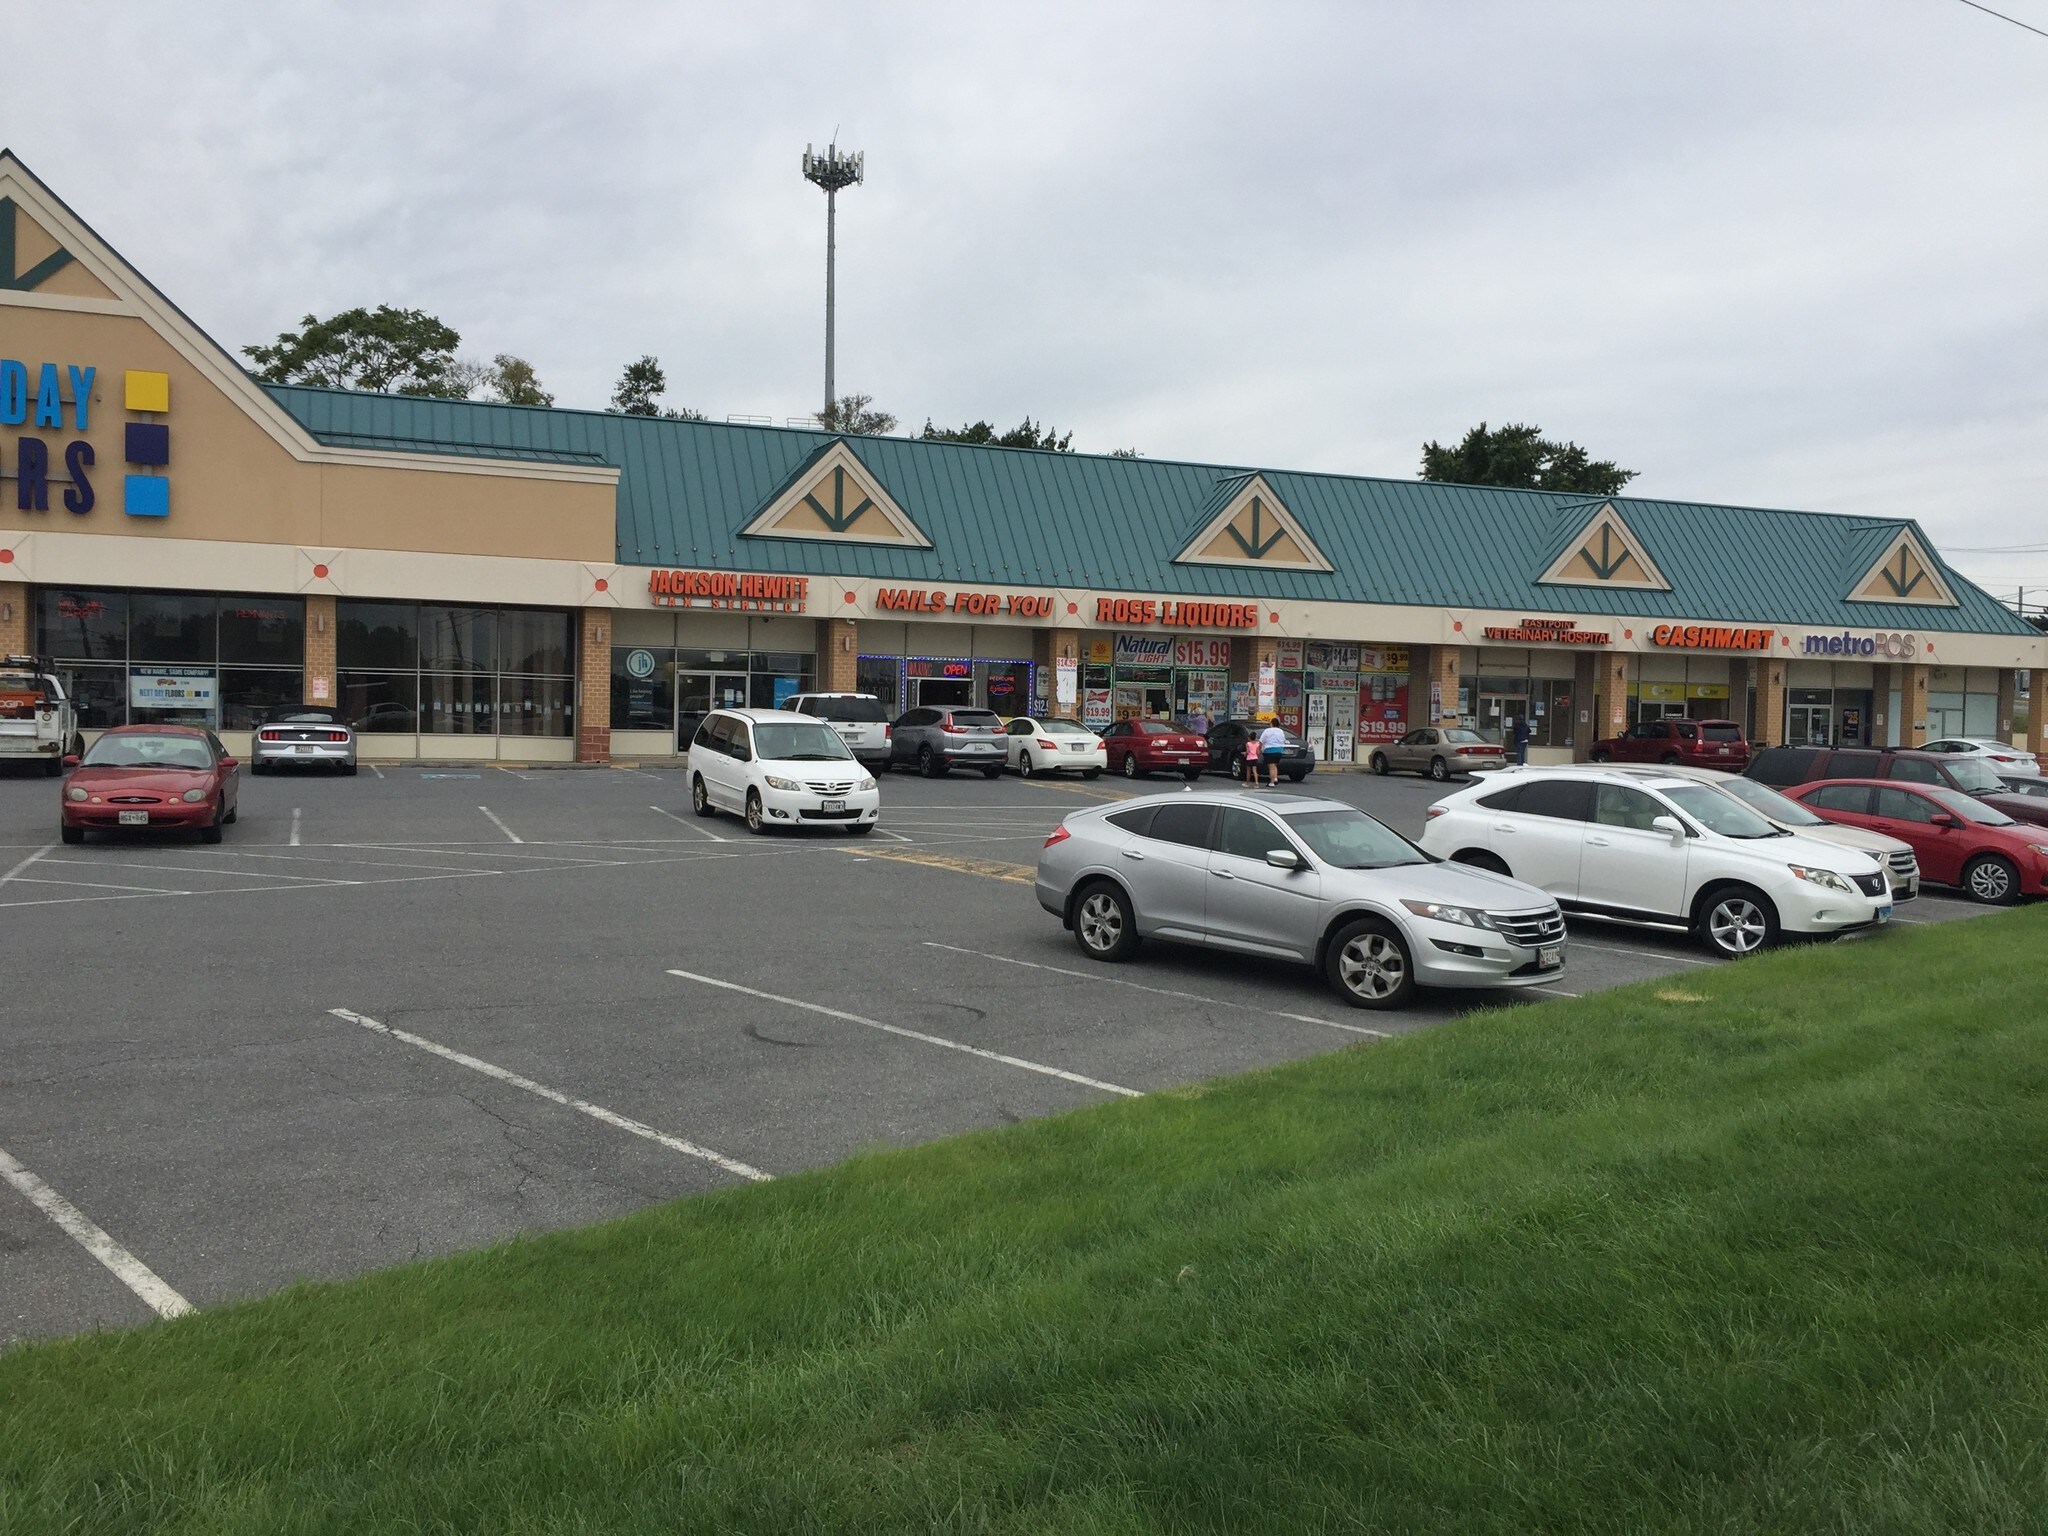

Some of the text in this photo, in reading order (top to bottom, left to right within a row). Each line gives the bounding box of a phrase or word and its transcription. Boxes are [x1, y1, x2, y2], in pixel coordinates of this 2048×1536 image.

[0, 360, 97, 430] DAY
[649, 570, 809, 600] JACKSON HEWITT
[652, 596, 807, 613] TAX SERVICE
[876, 588, 1055, 618] NAILS FOR YOU
[1096, 597, 1259, 628] ROSS LIQUORS
[1521, 618, 1578, 629] EASTPOINT
[1116, 635, 1173, 654] Natural
[1485, 627, 1613, 645] VETERINARY HOSPITAL
[1654, 624, 1775, 650] CASHMART
[1804, 631, 1916, 658] metroPCS
[1137, 653, 1167, 663] LIGHT
[1176, 640, 1230, 666] $15.99
[908, 662, 932, 677] WAXING
[943, 664, 968, 675] OPEN
[1086, 707, 1110, 717] $19.99
[1360, 721, 1407, 733] $19.99
